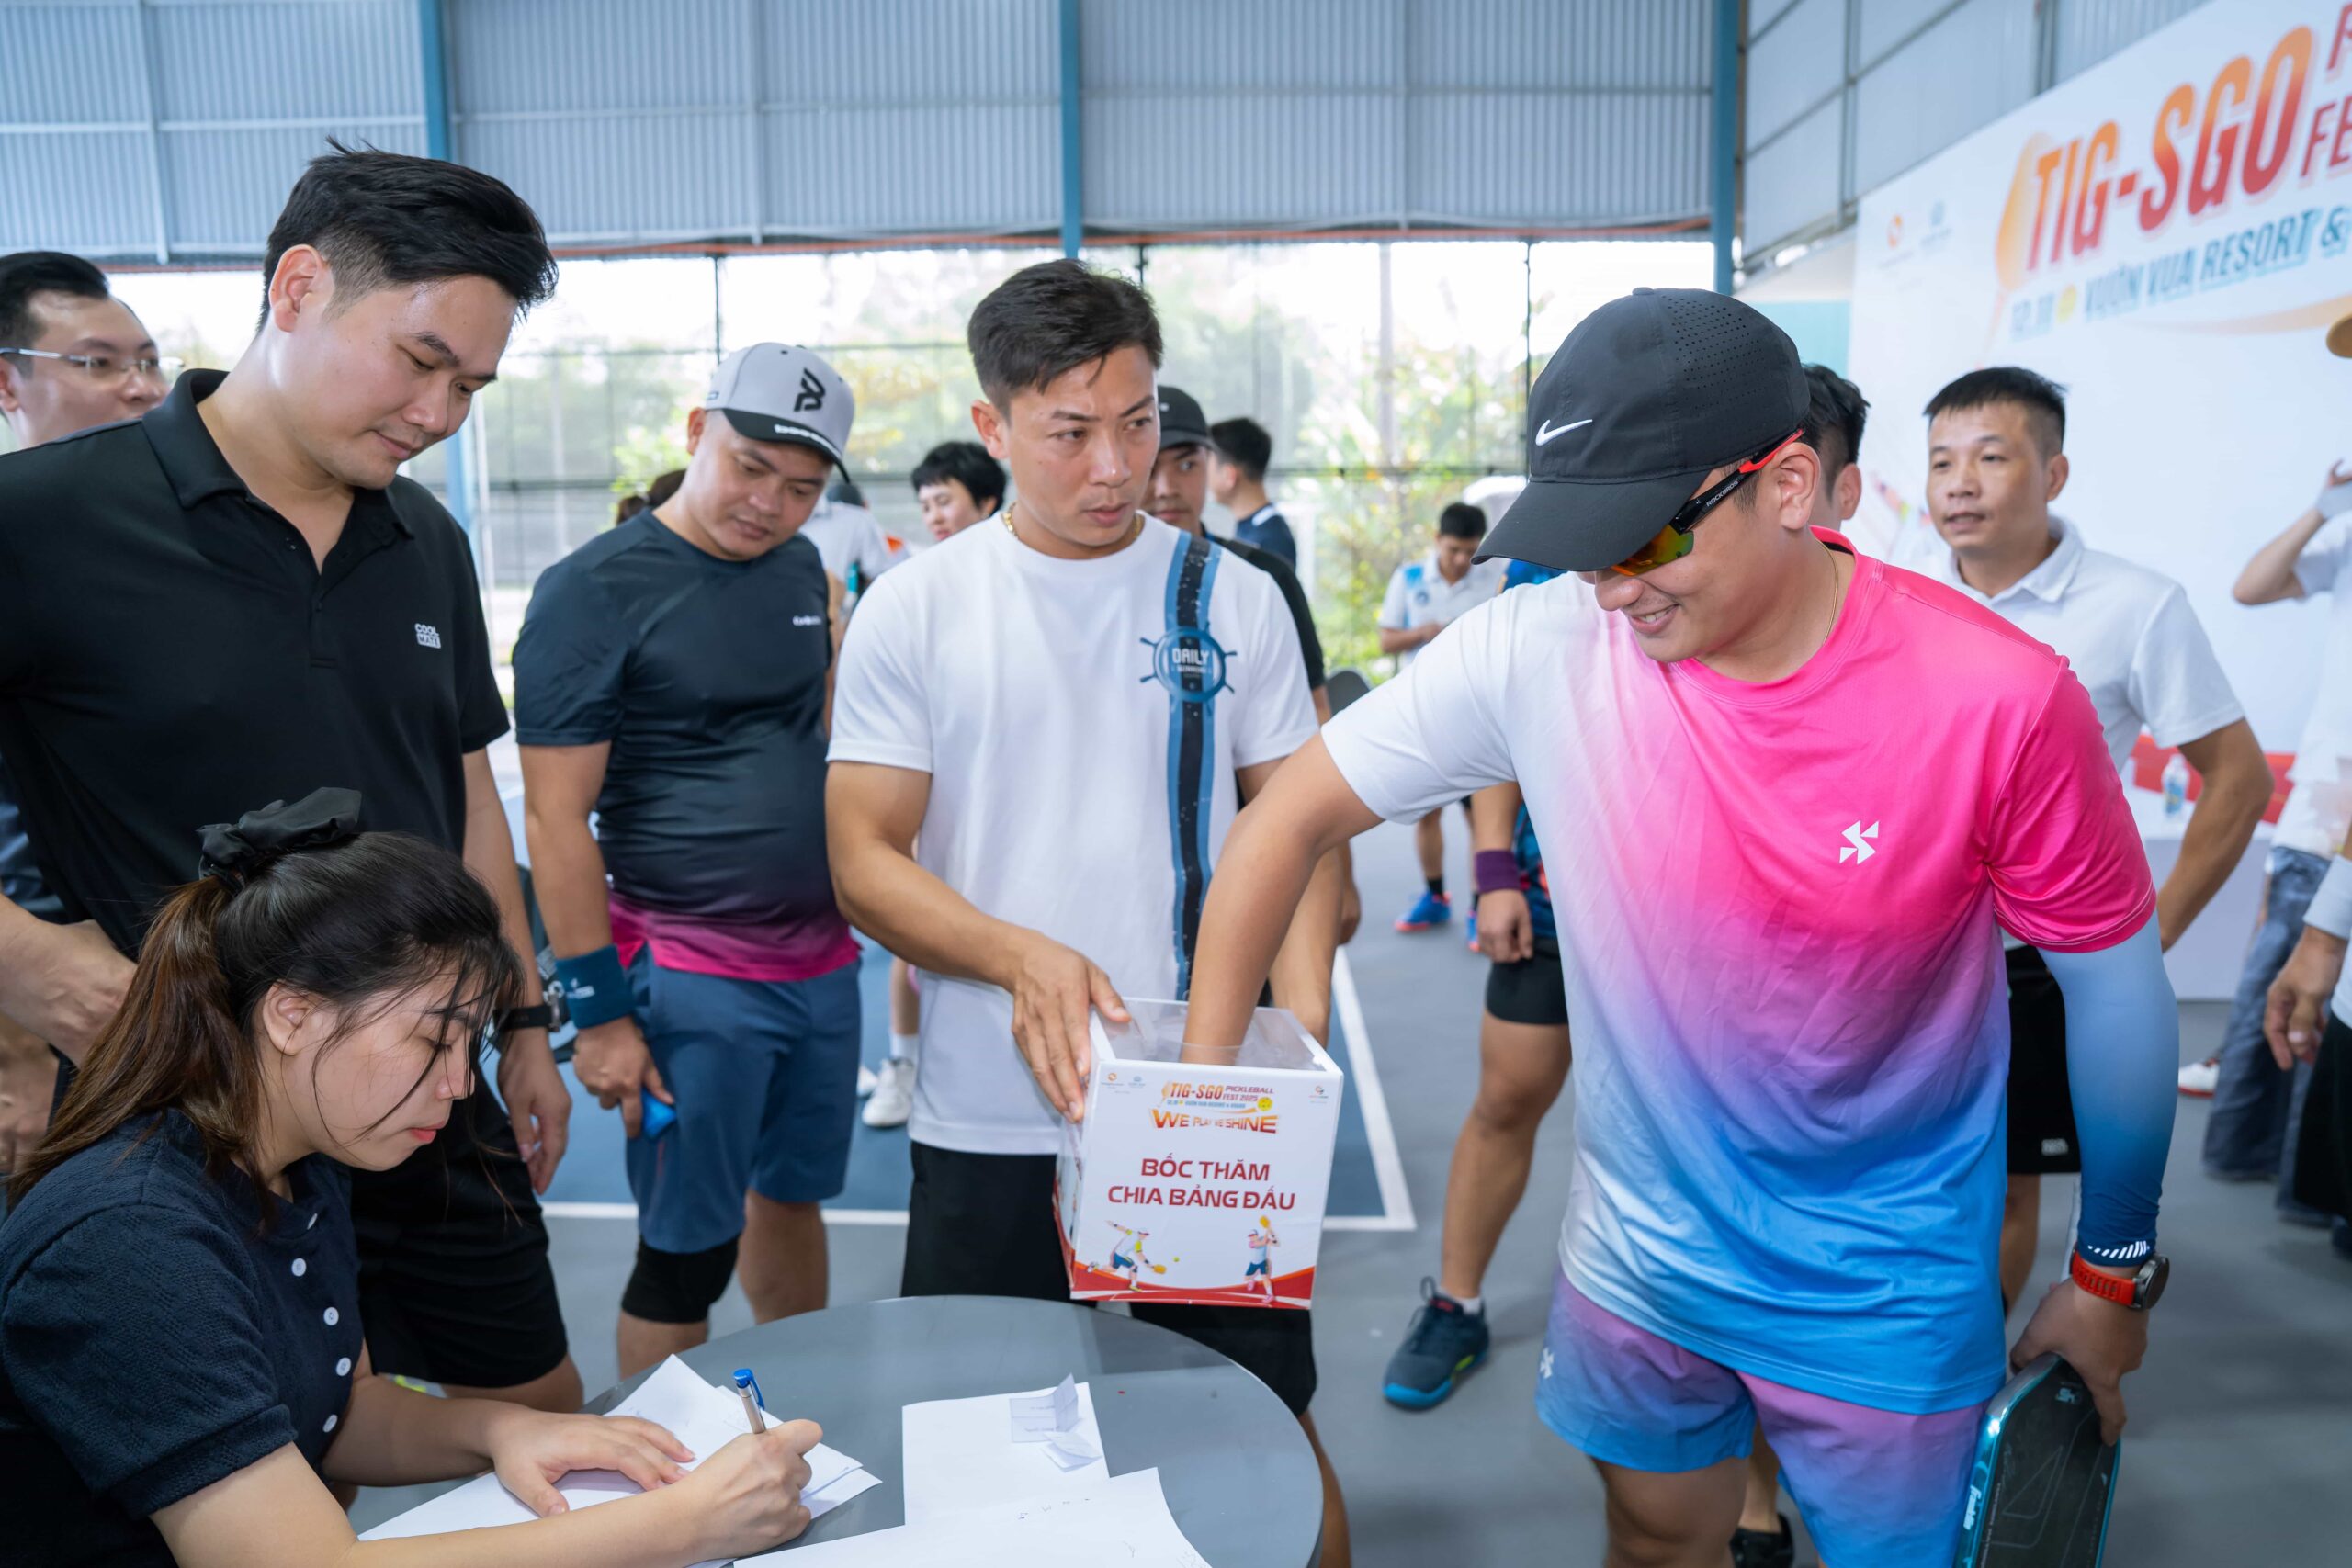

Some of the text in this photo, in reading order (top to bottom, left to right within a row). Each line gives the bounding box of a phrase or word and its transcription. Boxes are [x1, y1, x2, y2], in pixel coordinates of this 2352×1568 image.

[2025, 25, 2313, 273] TIG-SGO
[2199, 208, 2317, 283] RESORT
[1706, 479, 1739, 507] ROCKBROS
[1172, 648, 1209, 666] DAILY
[1170, 1082, 1224, 1100] TIG-SGO
[1223, 1093, 1259, 1102] FEST 2025
[1225, 1085, 1275, 1094] PICKLEBALL
[1152, 1109, 1191, 1128] WE
[1224, 1114, 1279, 1134] SHINE
[1140, 1153, 1271, 1181] BỐC THĂM
[1107, 1184, 1295, 1211] CHIA BẢNG ĐẤU
